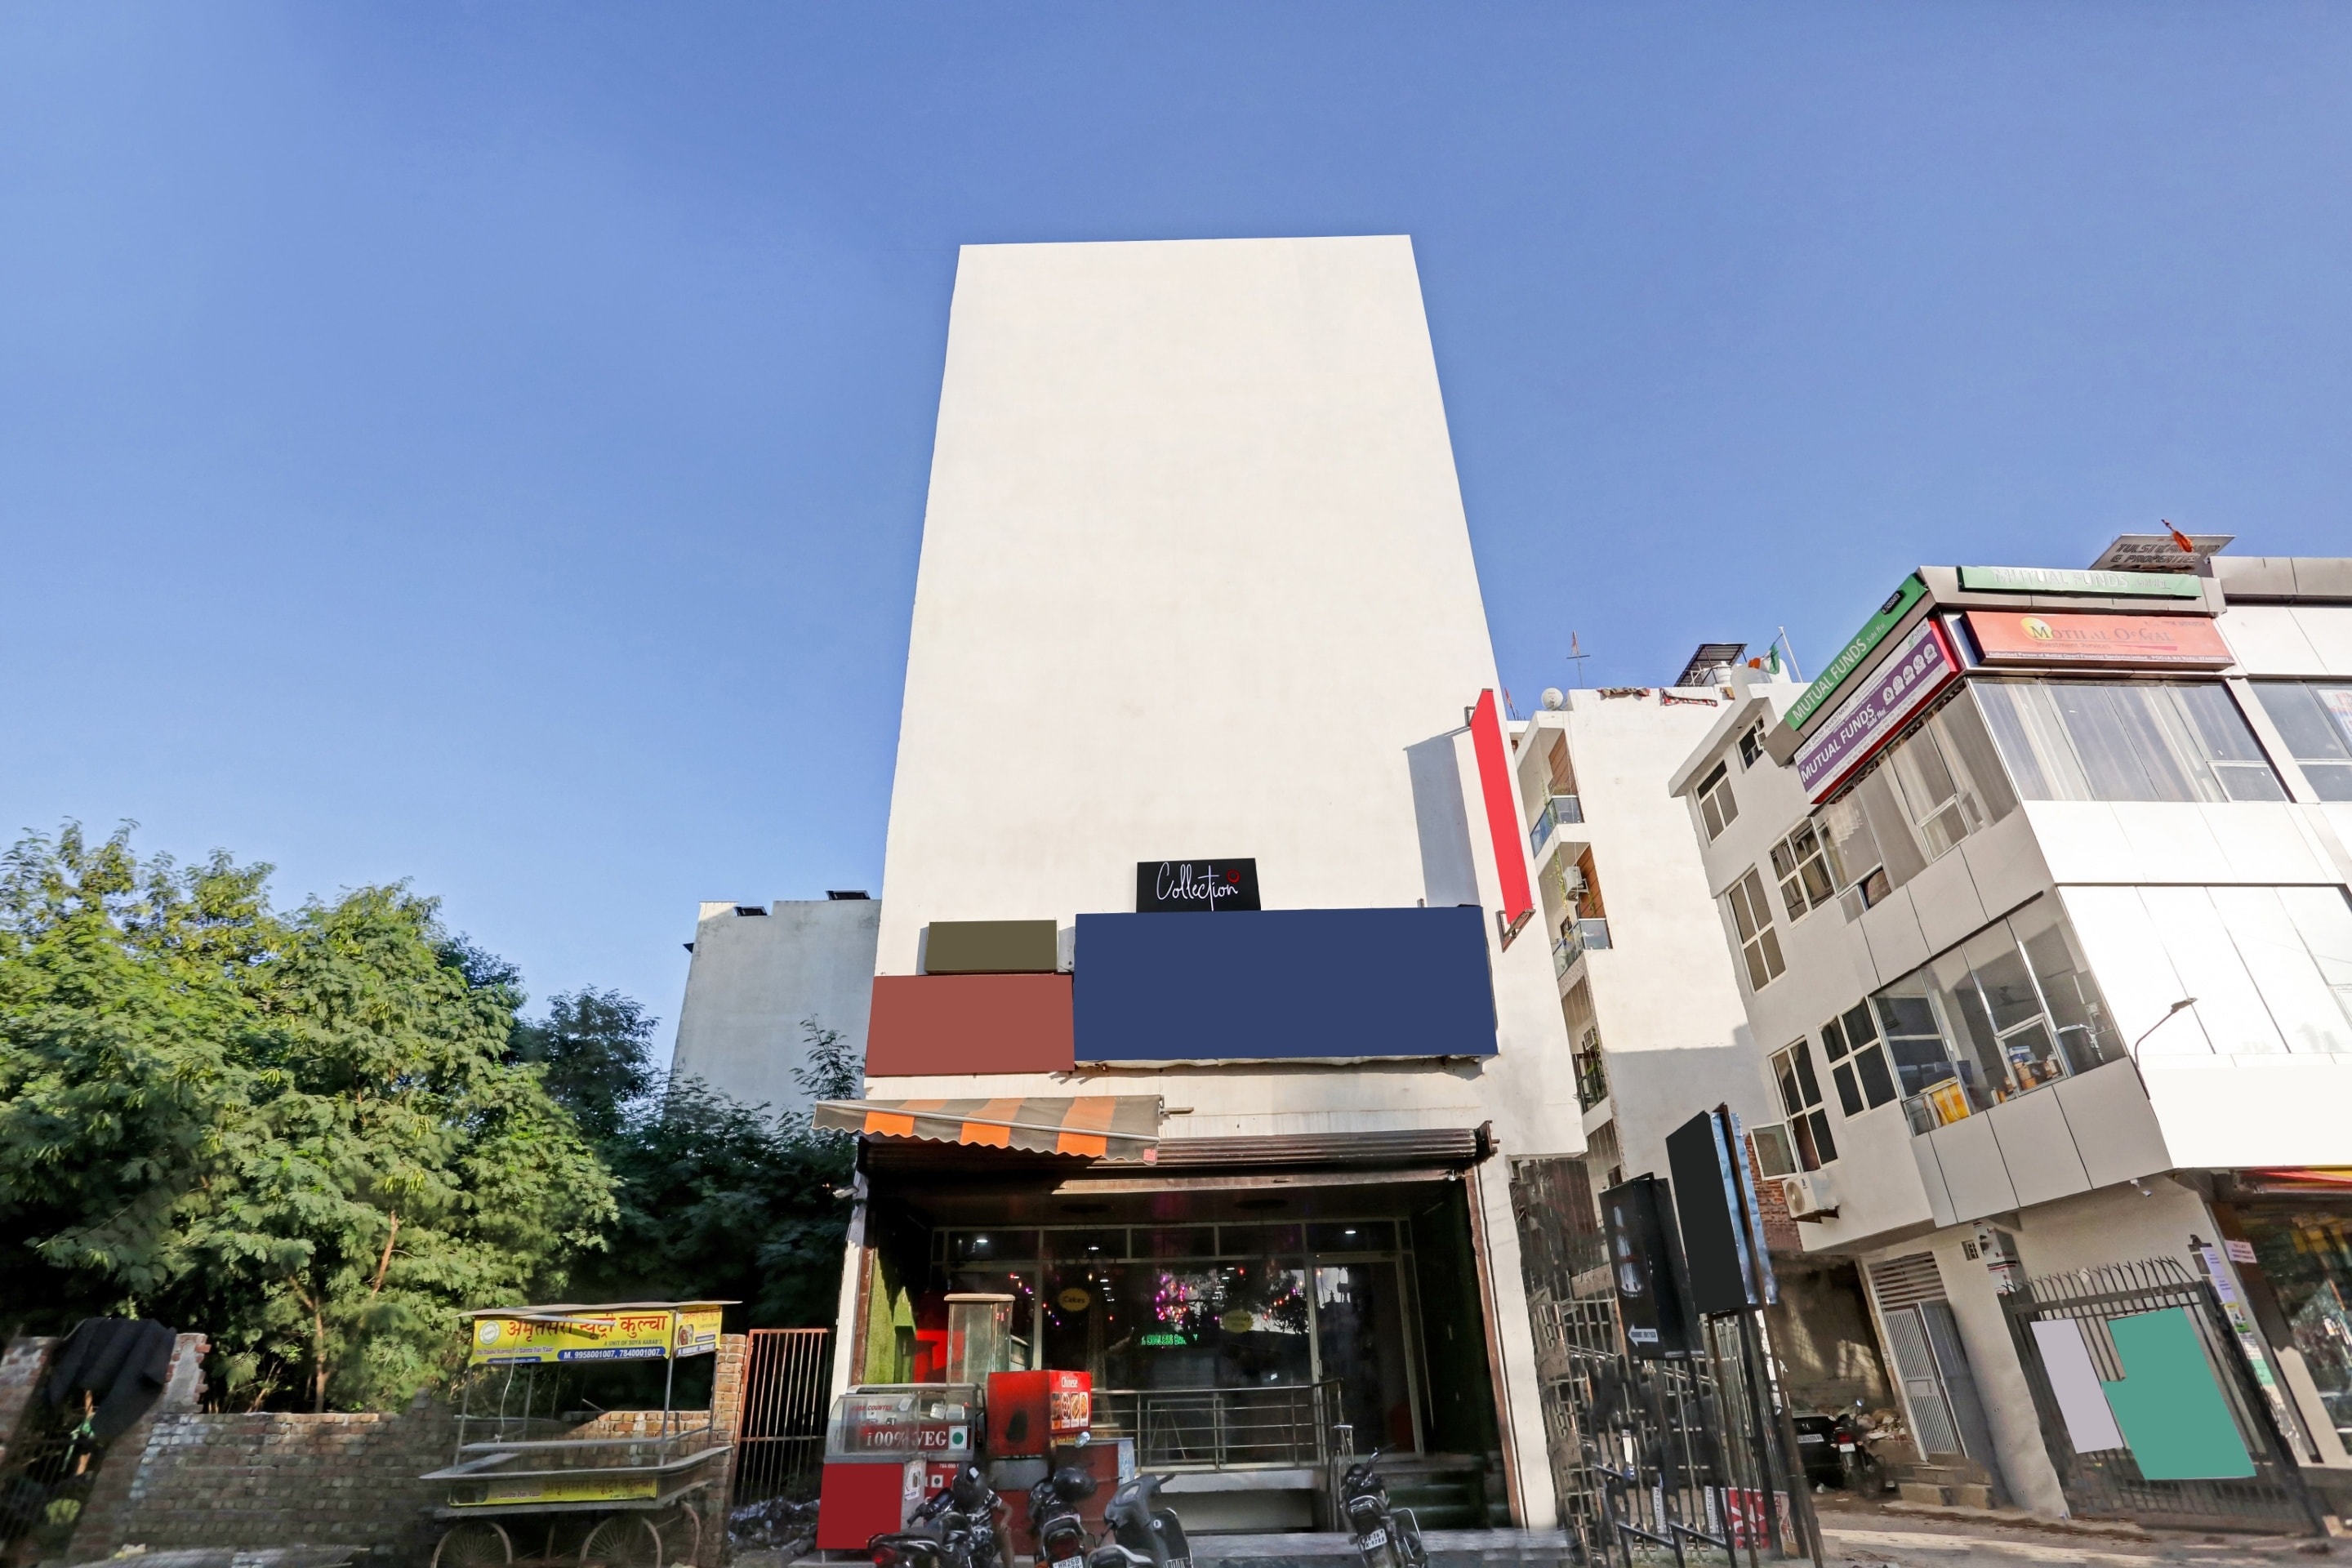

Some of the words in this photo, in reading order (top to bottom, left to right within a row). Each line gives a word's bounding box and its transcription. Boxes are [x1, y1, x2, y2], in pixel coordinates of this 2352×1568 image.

[2074, 572, 2128, 588] FUNDS
[1792, 675, 1834, 721] MUTUAL
[1830, 638, 1867, 679] FUNDS
[1824, 702, 1851, 730] INVESTMENT
[1866, 718, 1878, 729] Sahi
[1800, 739, 1842, 782] MUTUAL
[1840, 703, 1874, 744] FUNDS
[1156, 862, 1238, 911] Collection
[1063, 1295, 1085, 1303] Cakes
[619, 1316, 668, 1339] कुल्चा
[1061, 1375, 1078, 1388] Chinese
